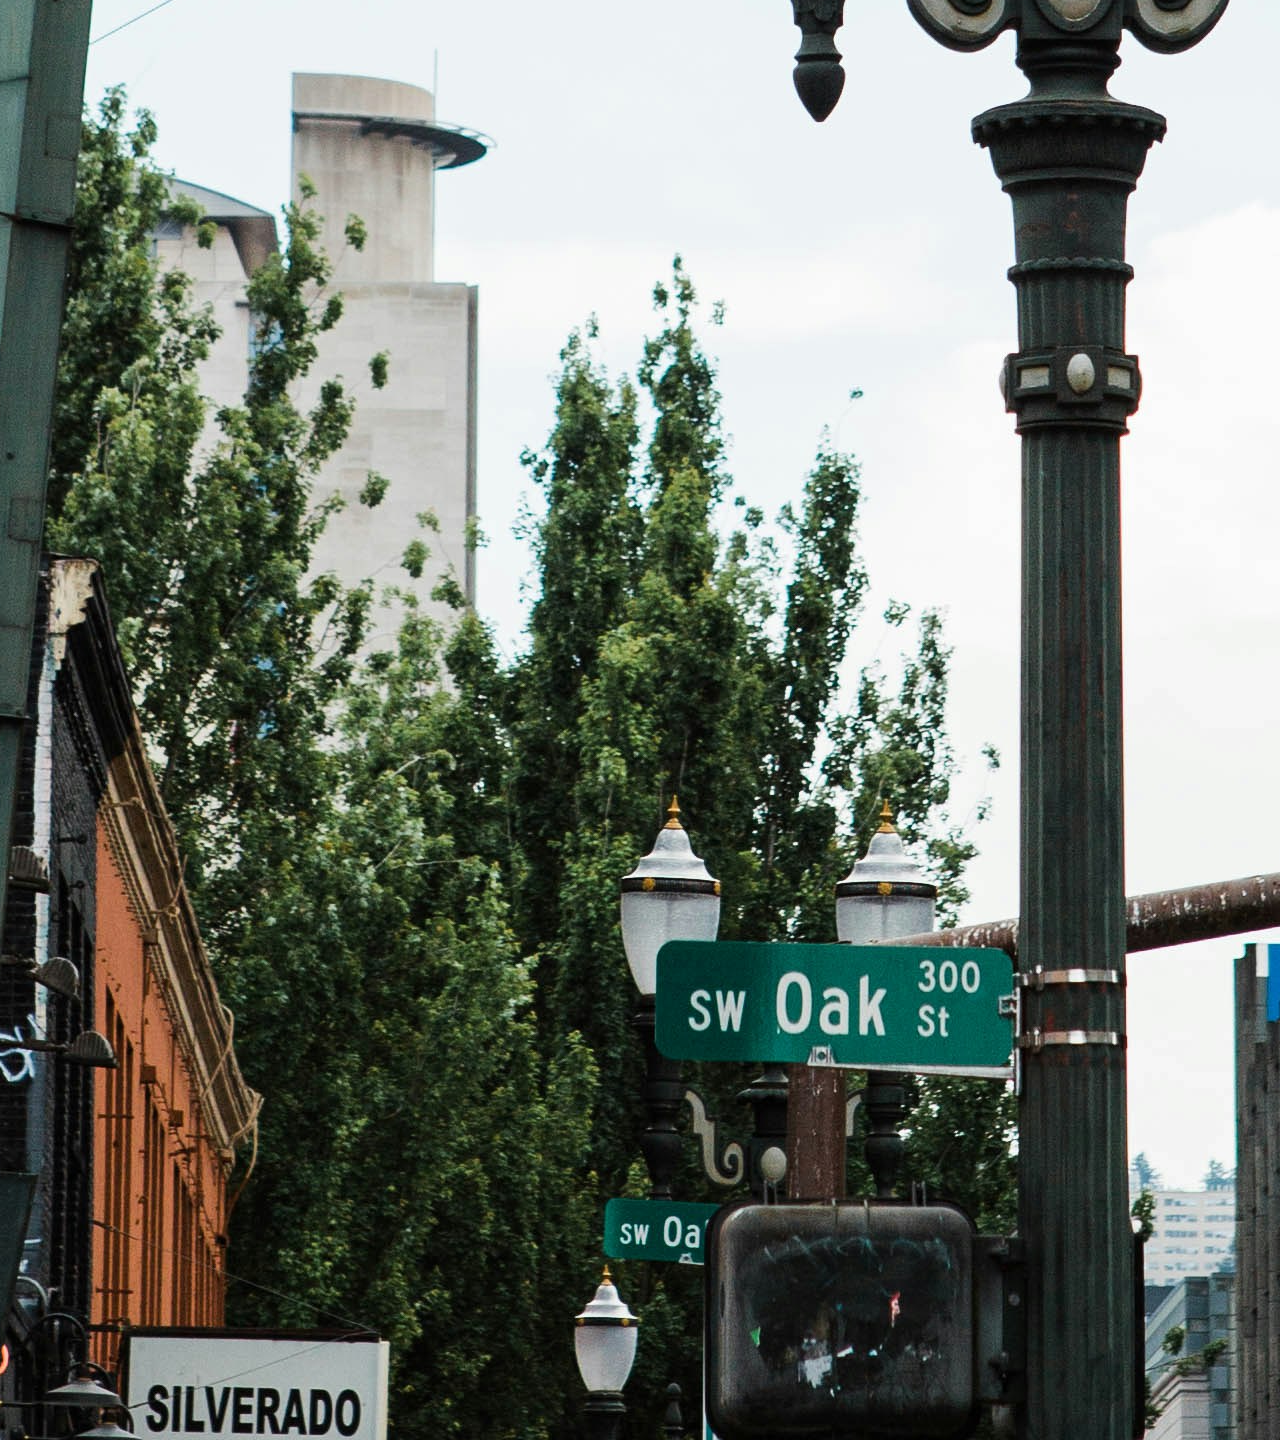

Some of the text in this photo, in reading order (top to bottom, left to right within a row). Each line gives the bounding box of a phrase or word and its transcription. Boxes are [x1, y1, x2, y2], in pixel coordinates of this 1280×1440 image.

[689, 961, 981, 1037] SW Oak 300
[918, 1004, 949, 1038] St
[620, 1216, 706, 1249] SW Oa
[145, 1383, 361, 1437] SILVERADO
